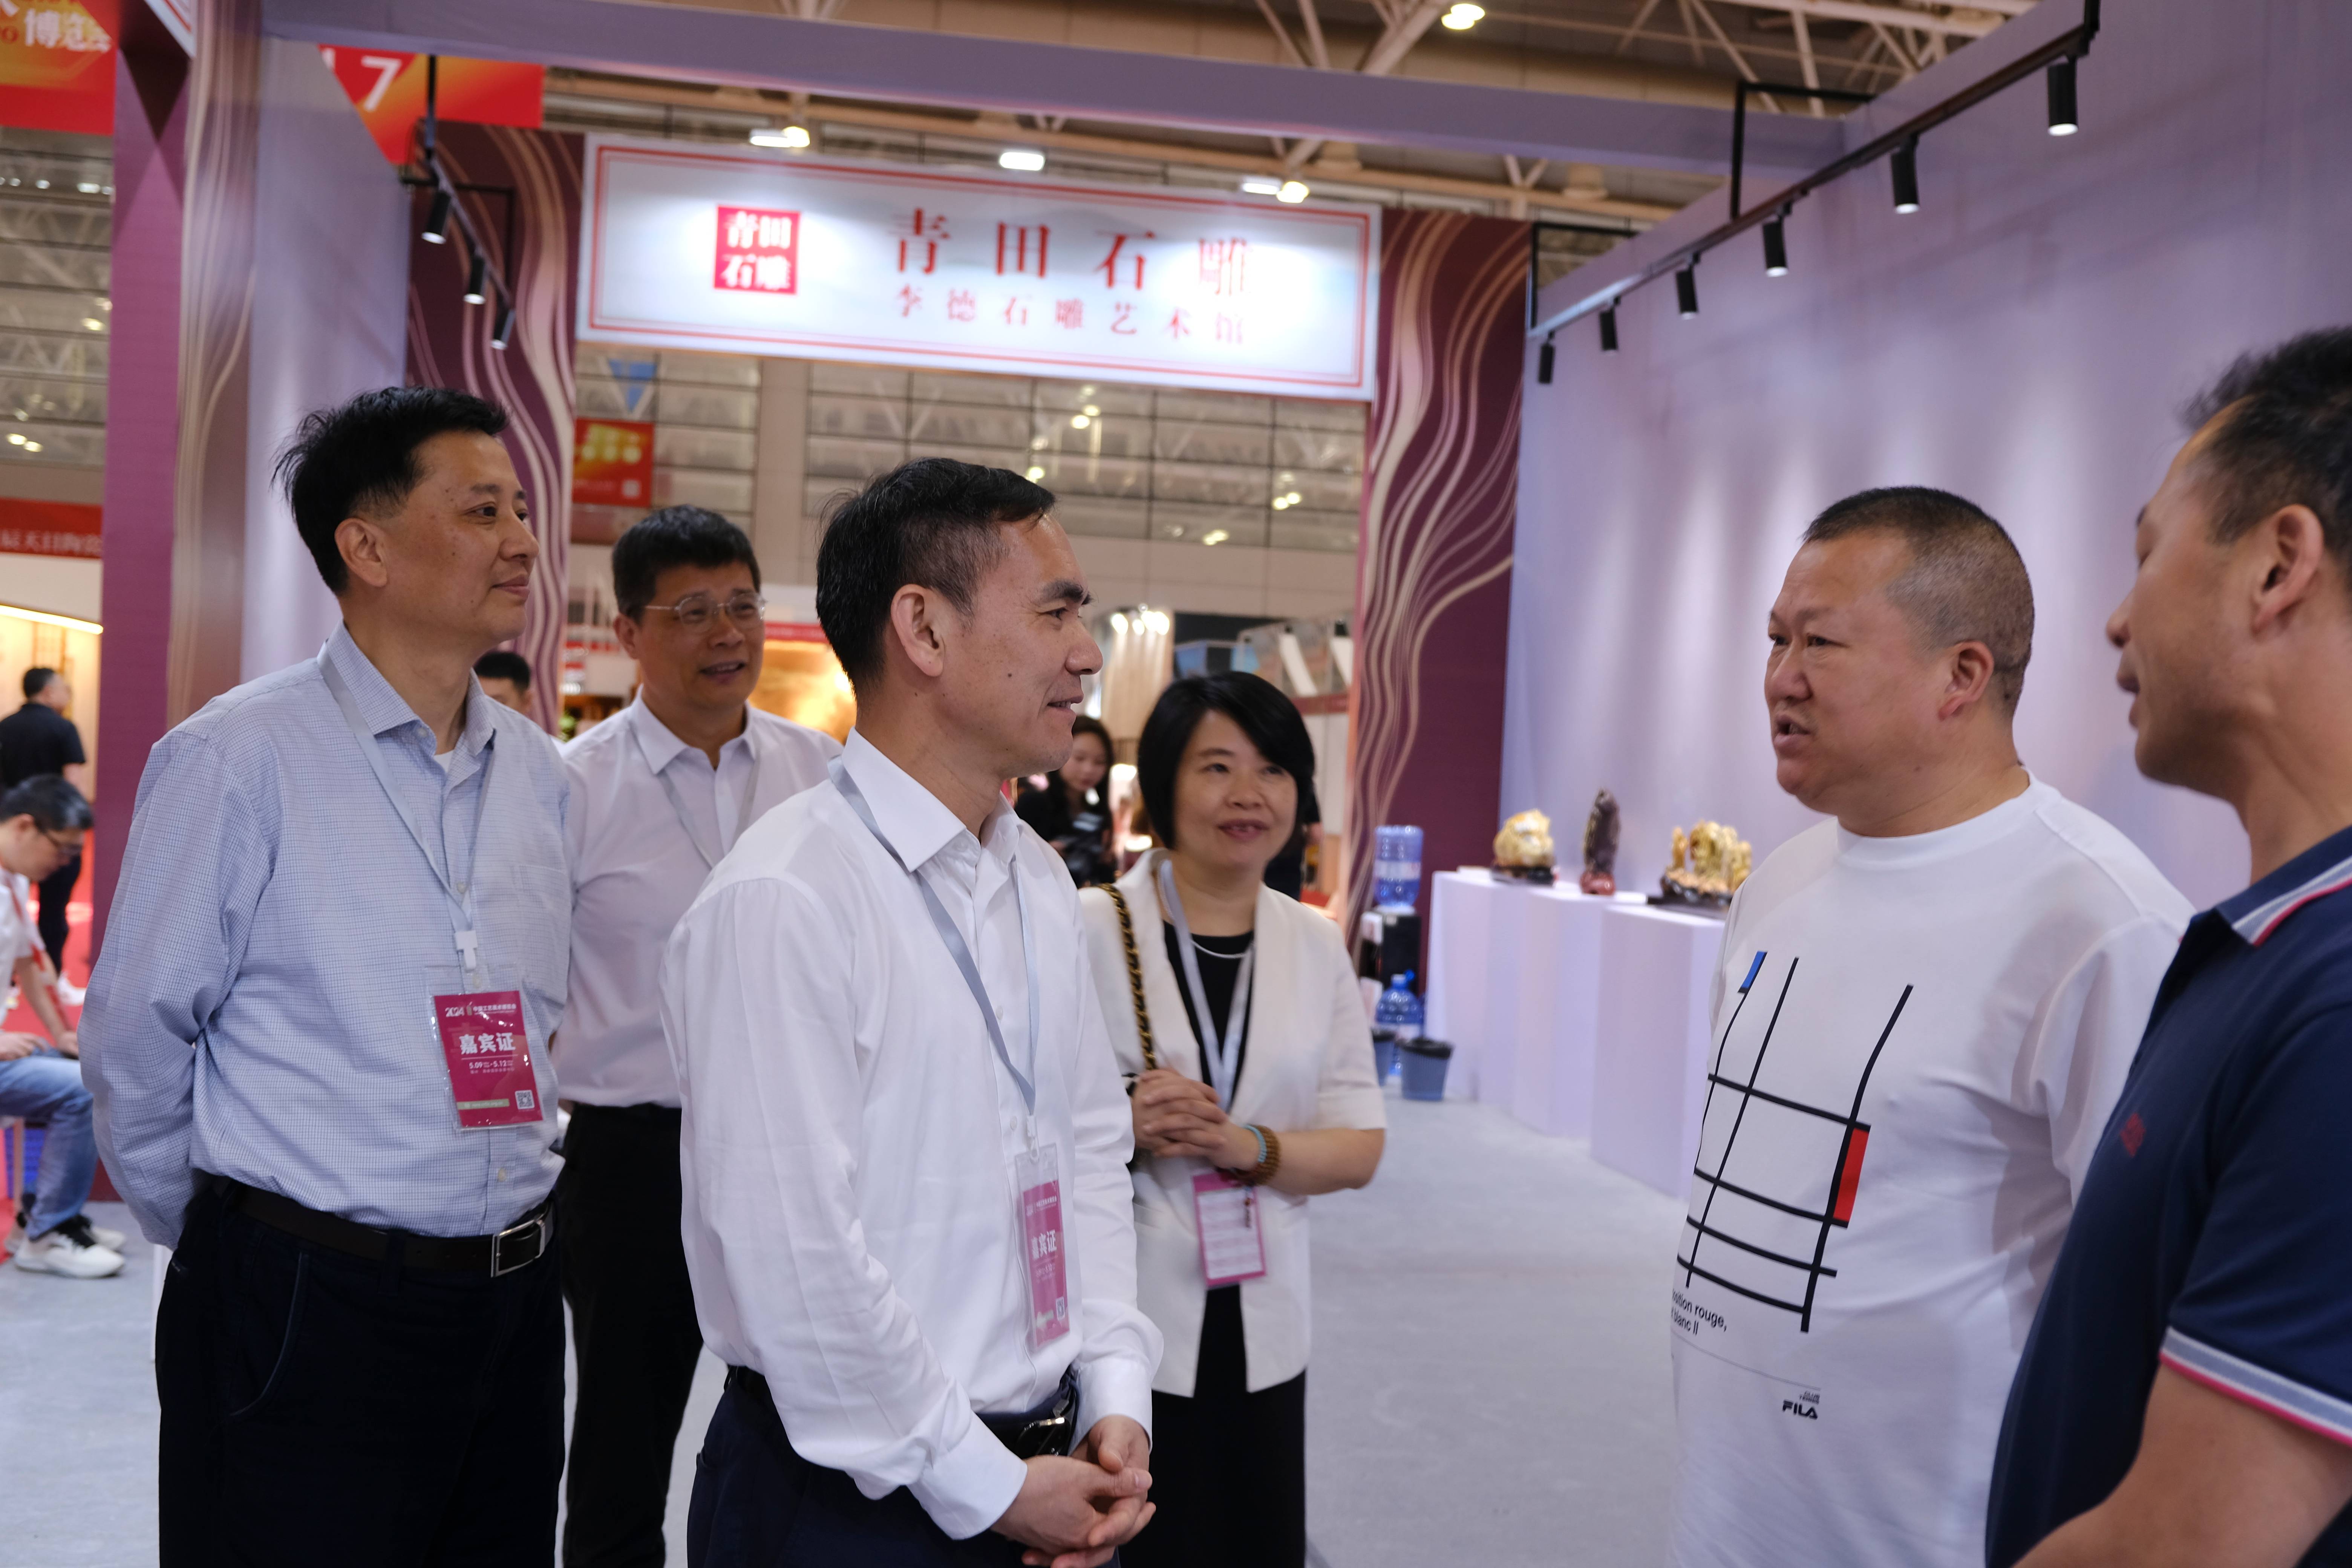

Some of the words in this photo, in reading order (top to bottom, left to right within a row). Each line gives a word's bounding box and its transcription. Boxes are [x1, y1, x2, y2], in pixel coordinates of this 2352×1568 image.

[887, 208, 1251, 296] 青田石雕
[445, 1006, 464, 1017] 2024
[459, 1032, 516, 1055] 嘉宾证
[1674, 1308, 1691, 1331] blanc
[1695, 1305, 1727, 1332] rouge,
[1782, 1399, 1818, 1419] FILA
